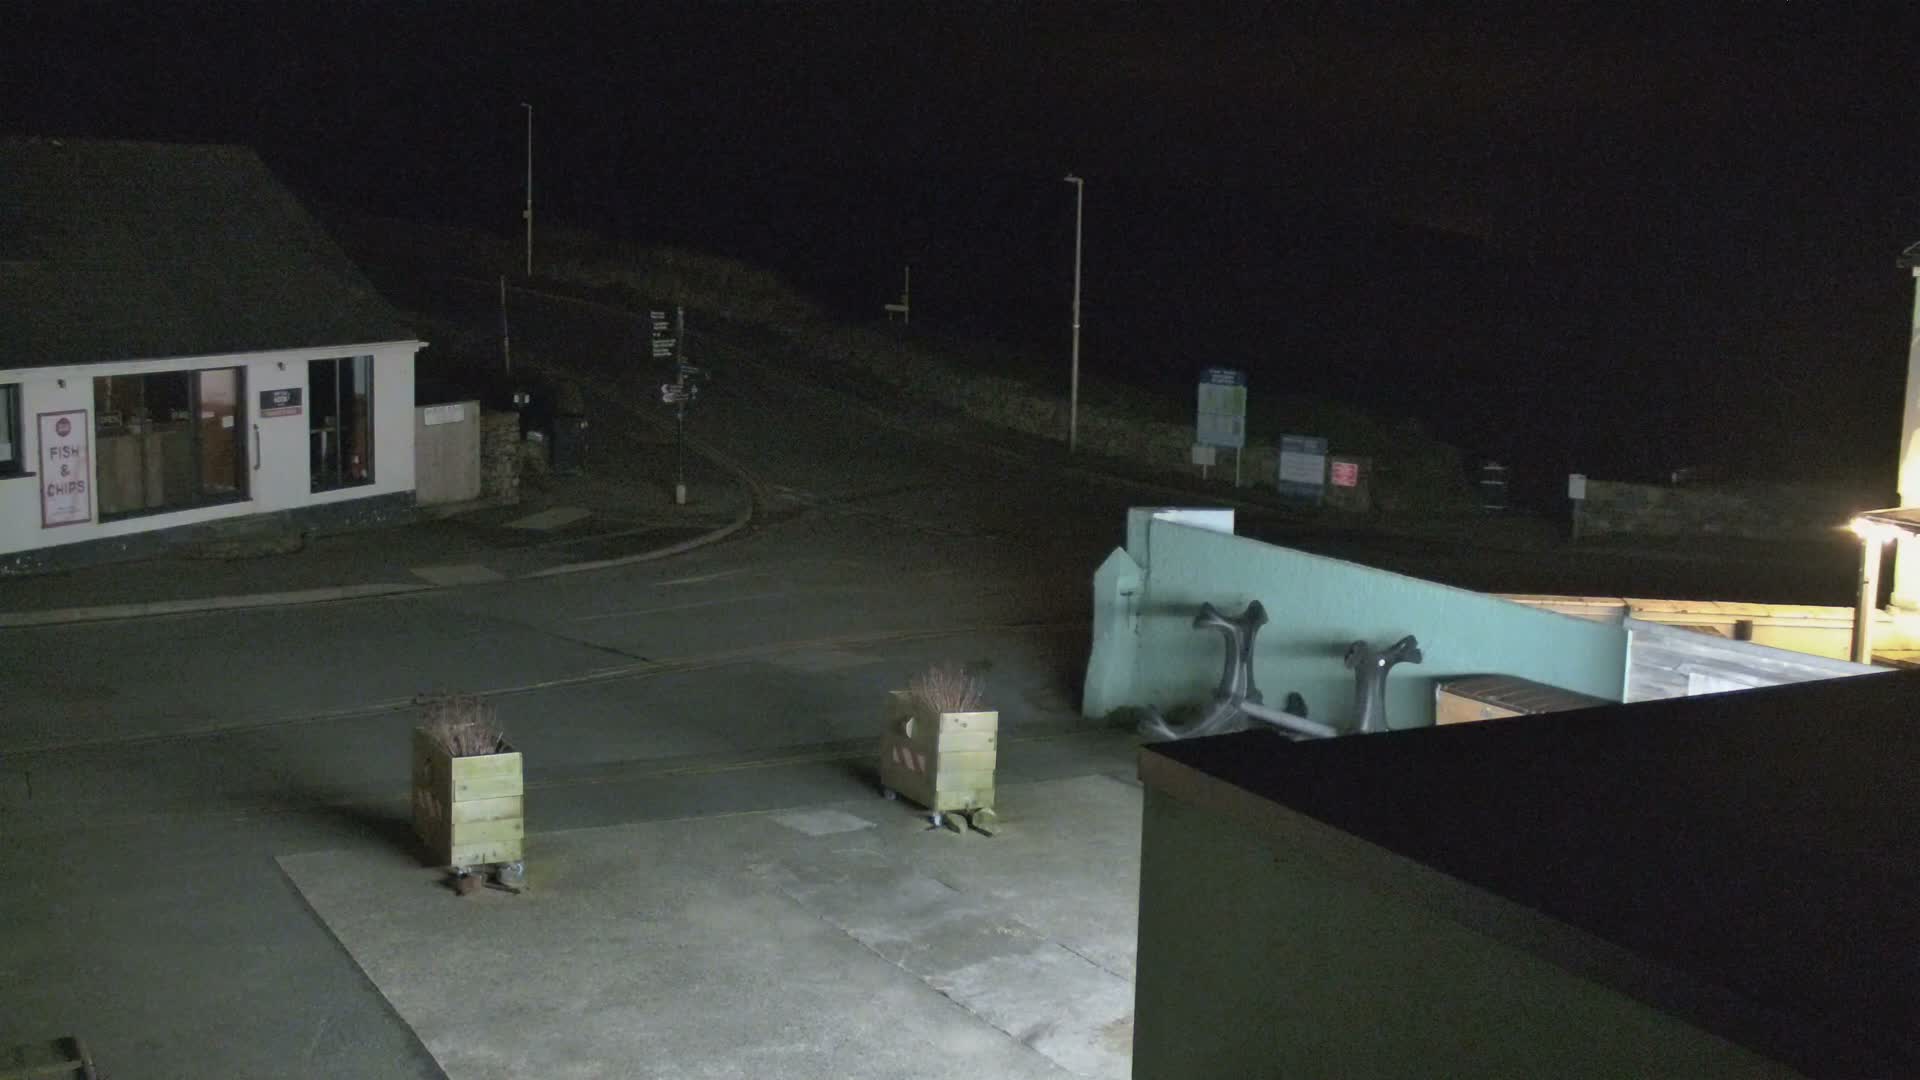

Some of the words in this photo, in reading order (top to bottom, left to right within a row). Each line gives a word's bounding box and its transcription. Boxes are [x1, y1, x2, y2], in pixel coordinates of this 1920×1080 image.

[50, 445, 79, 459] FISH
[60, 464, 70, 477] &
[47, 480, 85, 497] CHIPS
